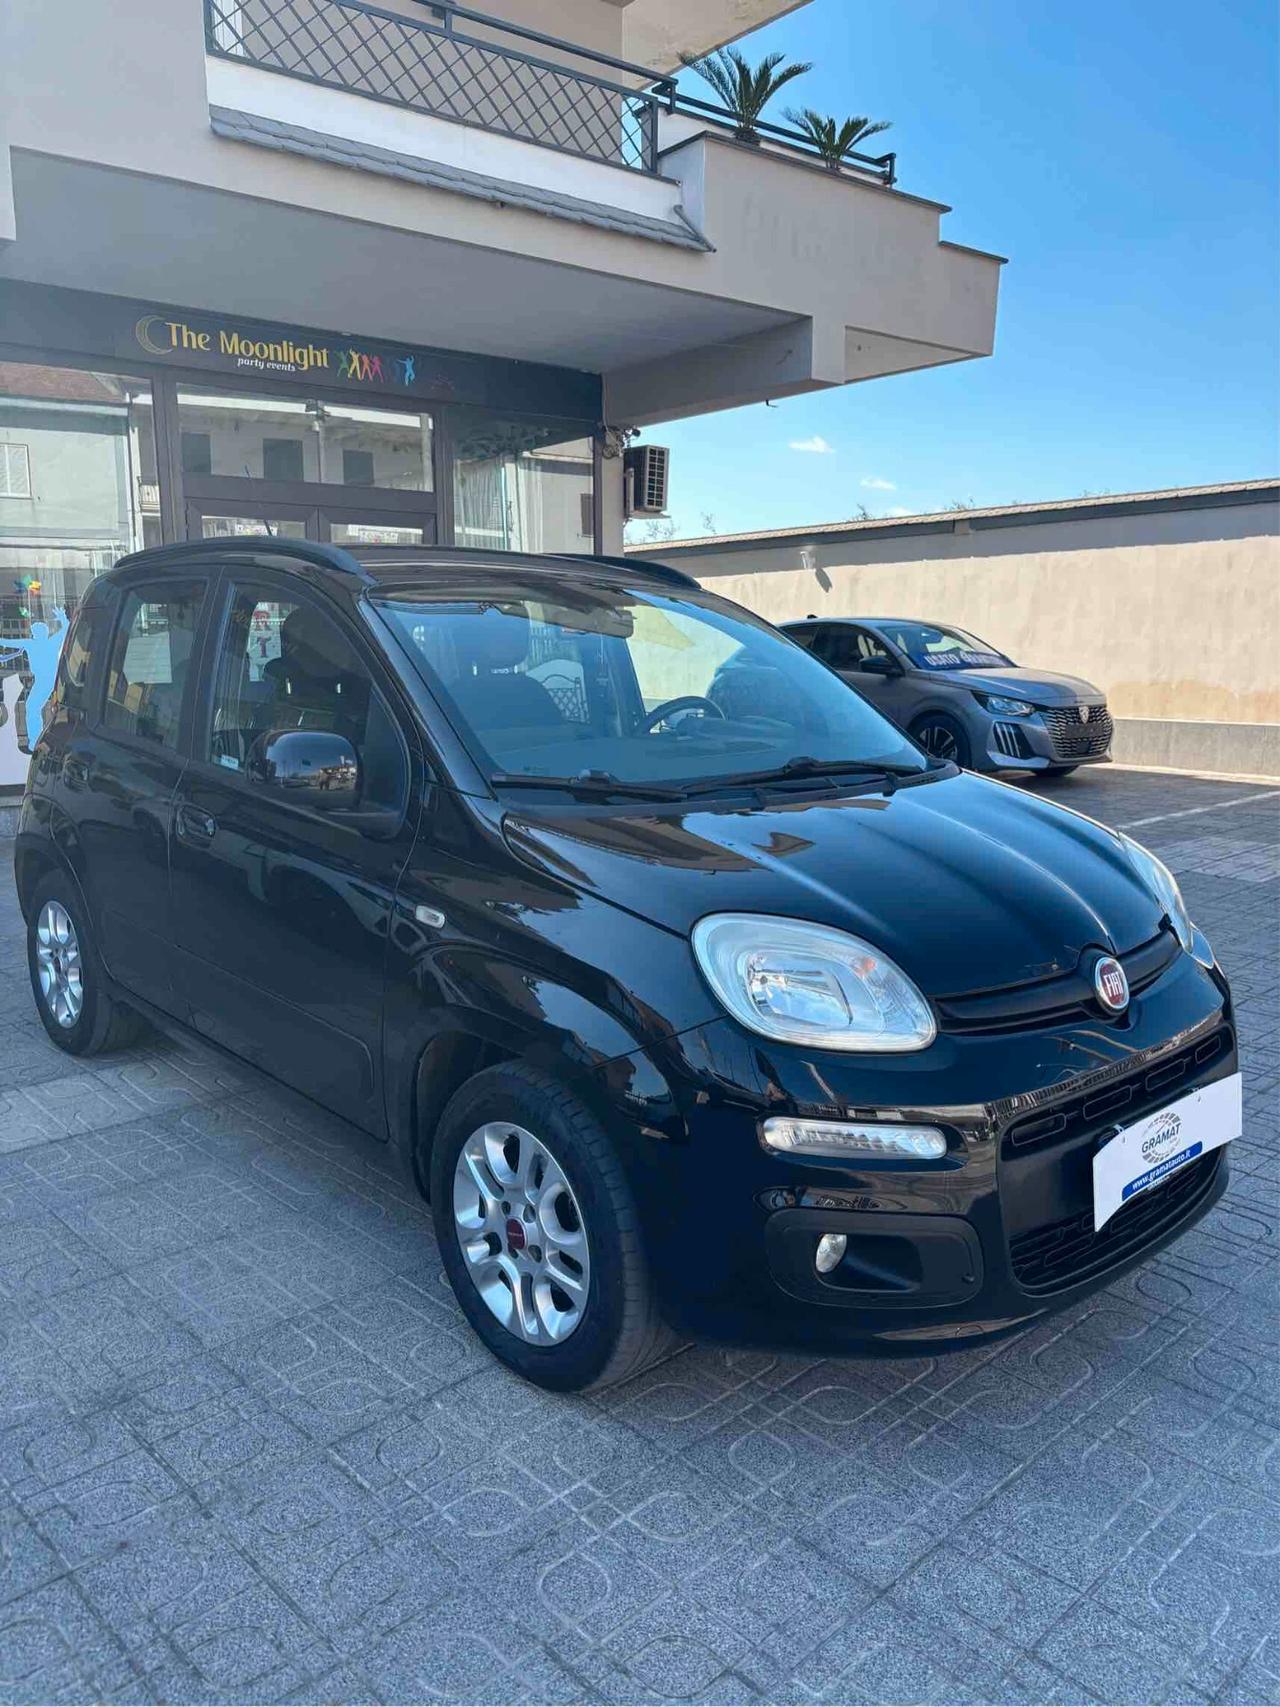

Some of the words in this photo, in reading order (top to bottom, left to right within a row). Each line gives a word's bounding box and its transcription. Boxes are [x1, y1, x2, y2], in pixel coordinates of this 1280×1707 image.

[165, 322, 211, 351] The
[219, 330, 330, 371] Moonlight
[237, 357, 265, 369] party
[266, 361, 297, 372] events
[1103, 971, 1124, 997] FIAT
[1141, 1122, 1181, 1153] GRAMAT
[1131, 1150, 1191, 1190] www.gramatauto.it
